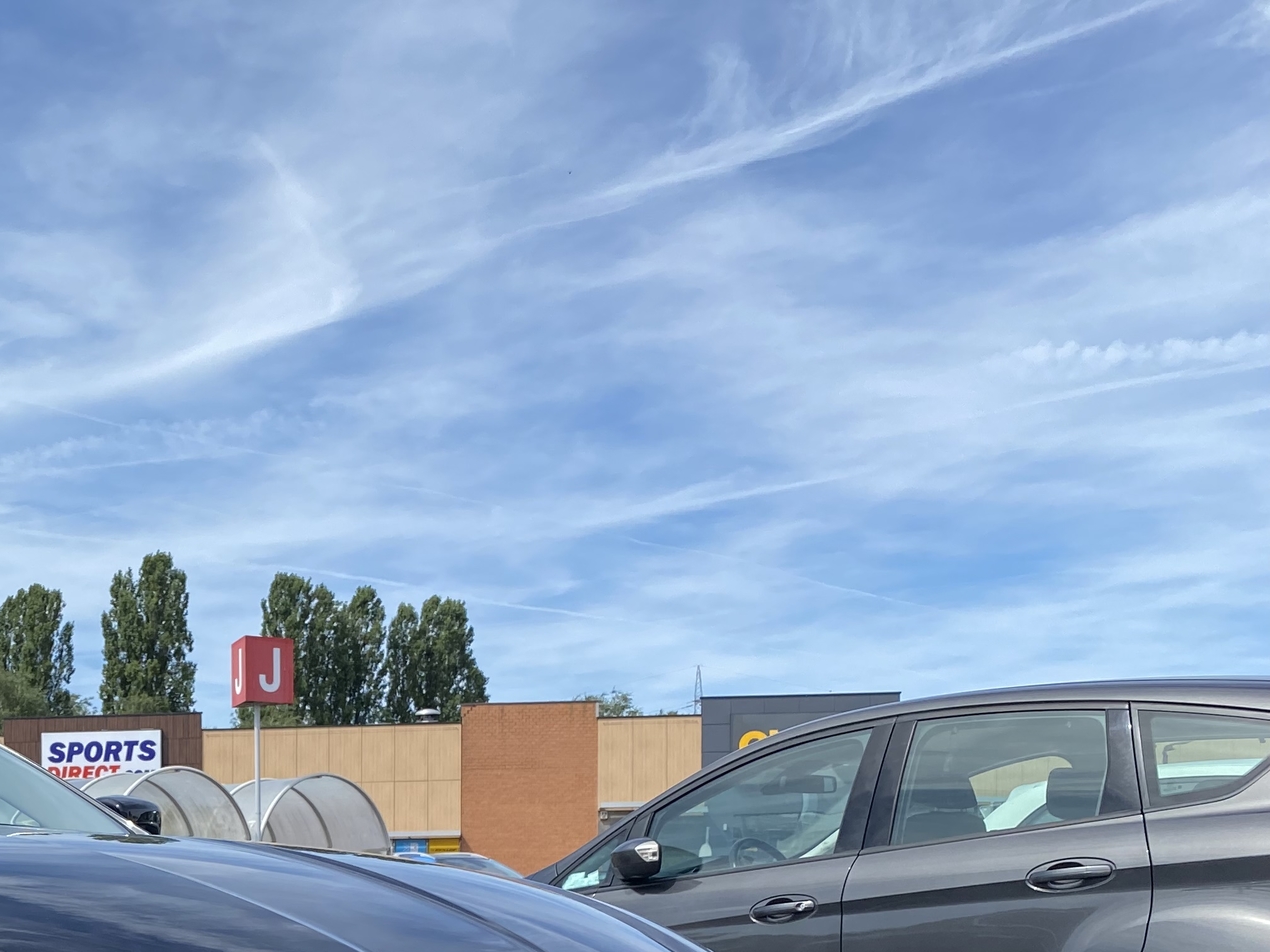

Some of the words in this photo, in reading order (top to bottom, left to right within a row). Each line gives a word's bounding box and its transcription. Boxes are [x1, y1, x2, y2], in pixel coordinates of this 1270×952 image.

[234, 648, 242, 695] J
[259, 647, 281, 693] J
[47, 740, 157, 763] SPORTS
